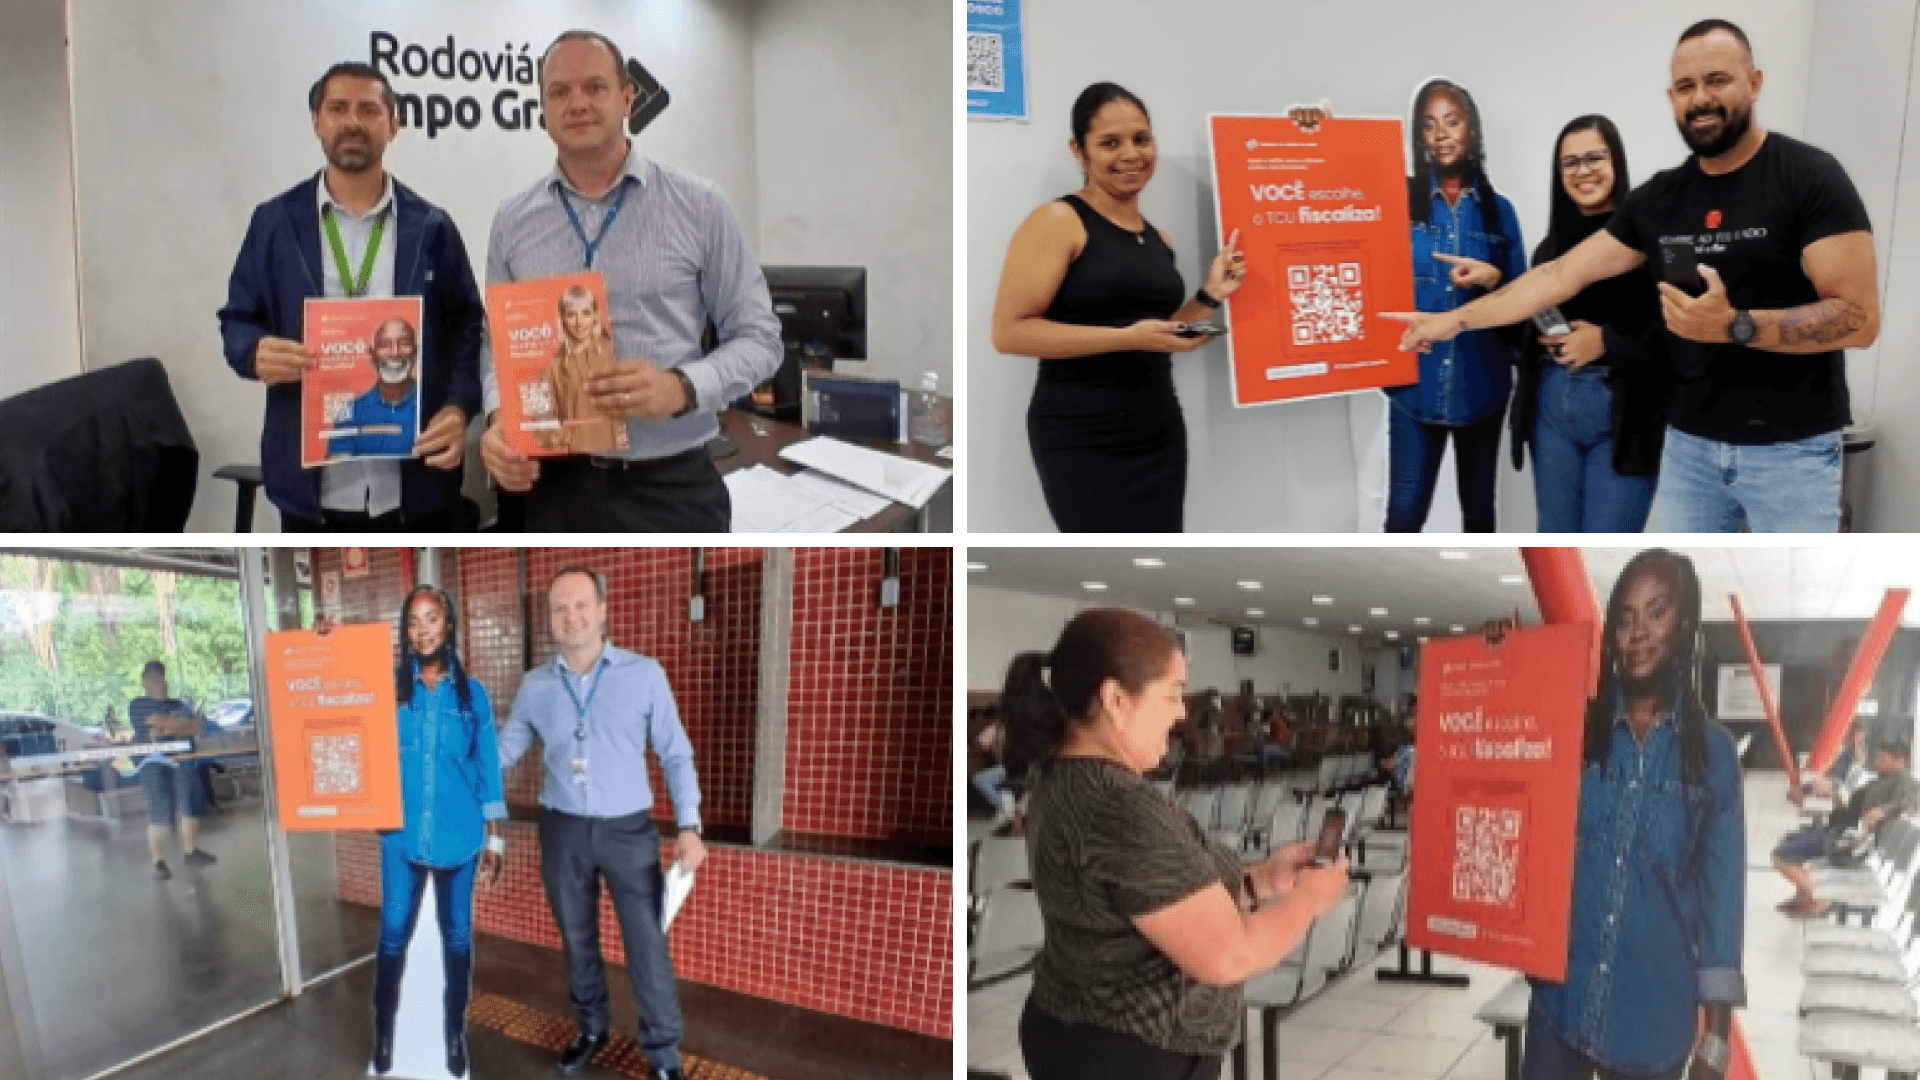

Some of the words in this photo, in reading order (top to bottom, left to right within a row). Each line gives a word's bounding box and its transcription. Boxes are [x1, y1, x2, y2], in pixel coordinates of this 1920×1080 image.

[370, 31, 543, 84] Rodoviá
[394, 92, 482, 138] mpo
[1249, 179, 1305, 202] VOCÊ
